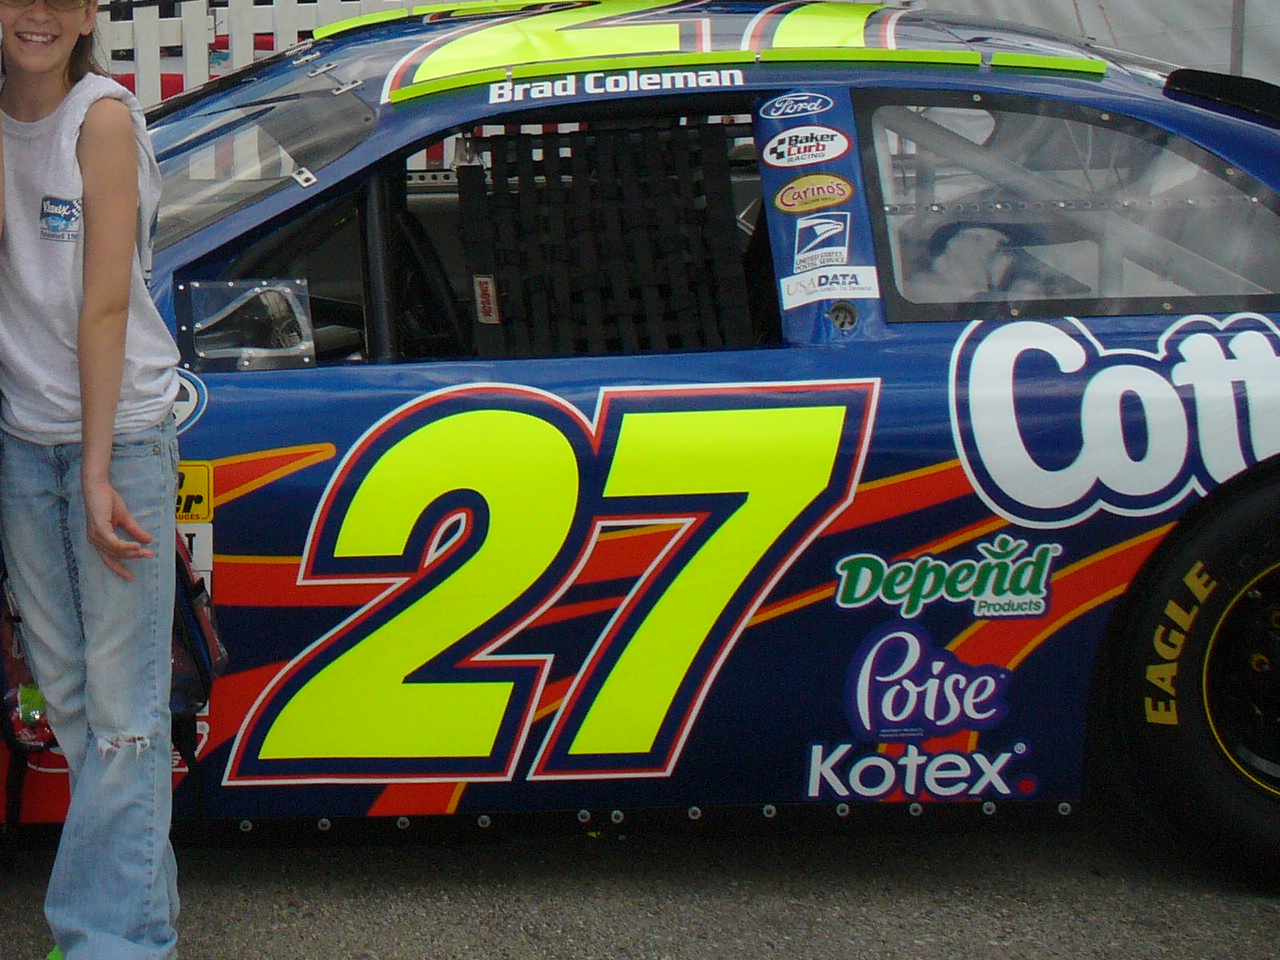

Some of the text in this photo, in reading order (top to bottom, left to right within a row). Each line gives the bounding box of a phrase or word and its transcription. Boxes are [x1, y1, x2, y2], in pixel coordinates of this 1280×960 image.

[489, 69, 745, 105] Brad Coleman
[770, 95, 823, 116] Ford
[786, 142, 827, 157] Curb
[787, 132, 838, 146] Baker
[786, 152, 826, 164] RACING
[240, 392, 865, 772] 27
[837, 544, 1051, 617] Depend
[977, 598, 1043, 614] Products
[1145, 560, 1219, 726] EAGLE
[858, 631, 999, 731] Poise
